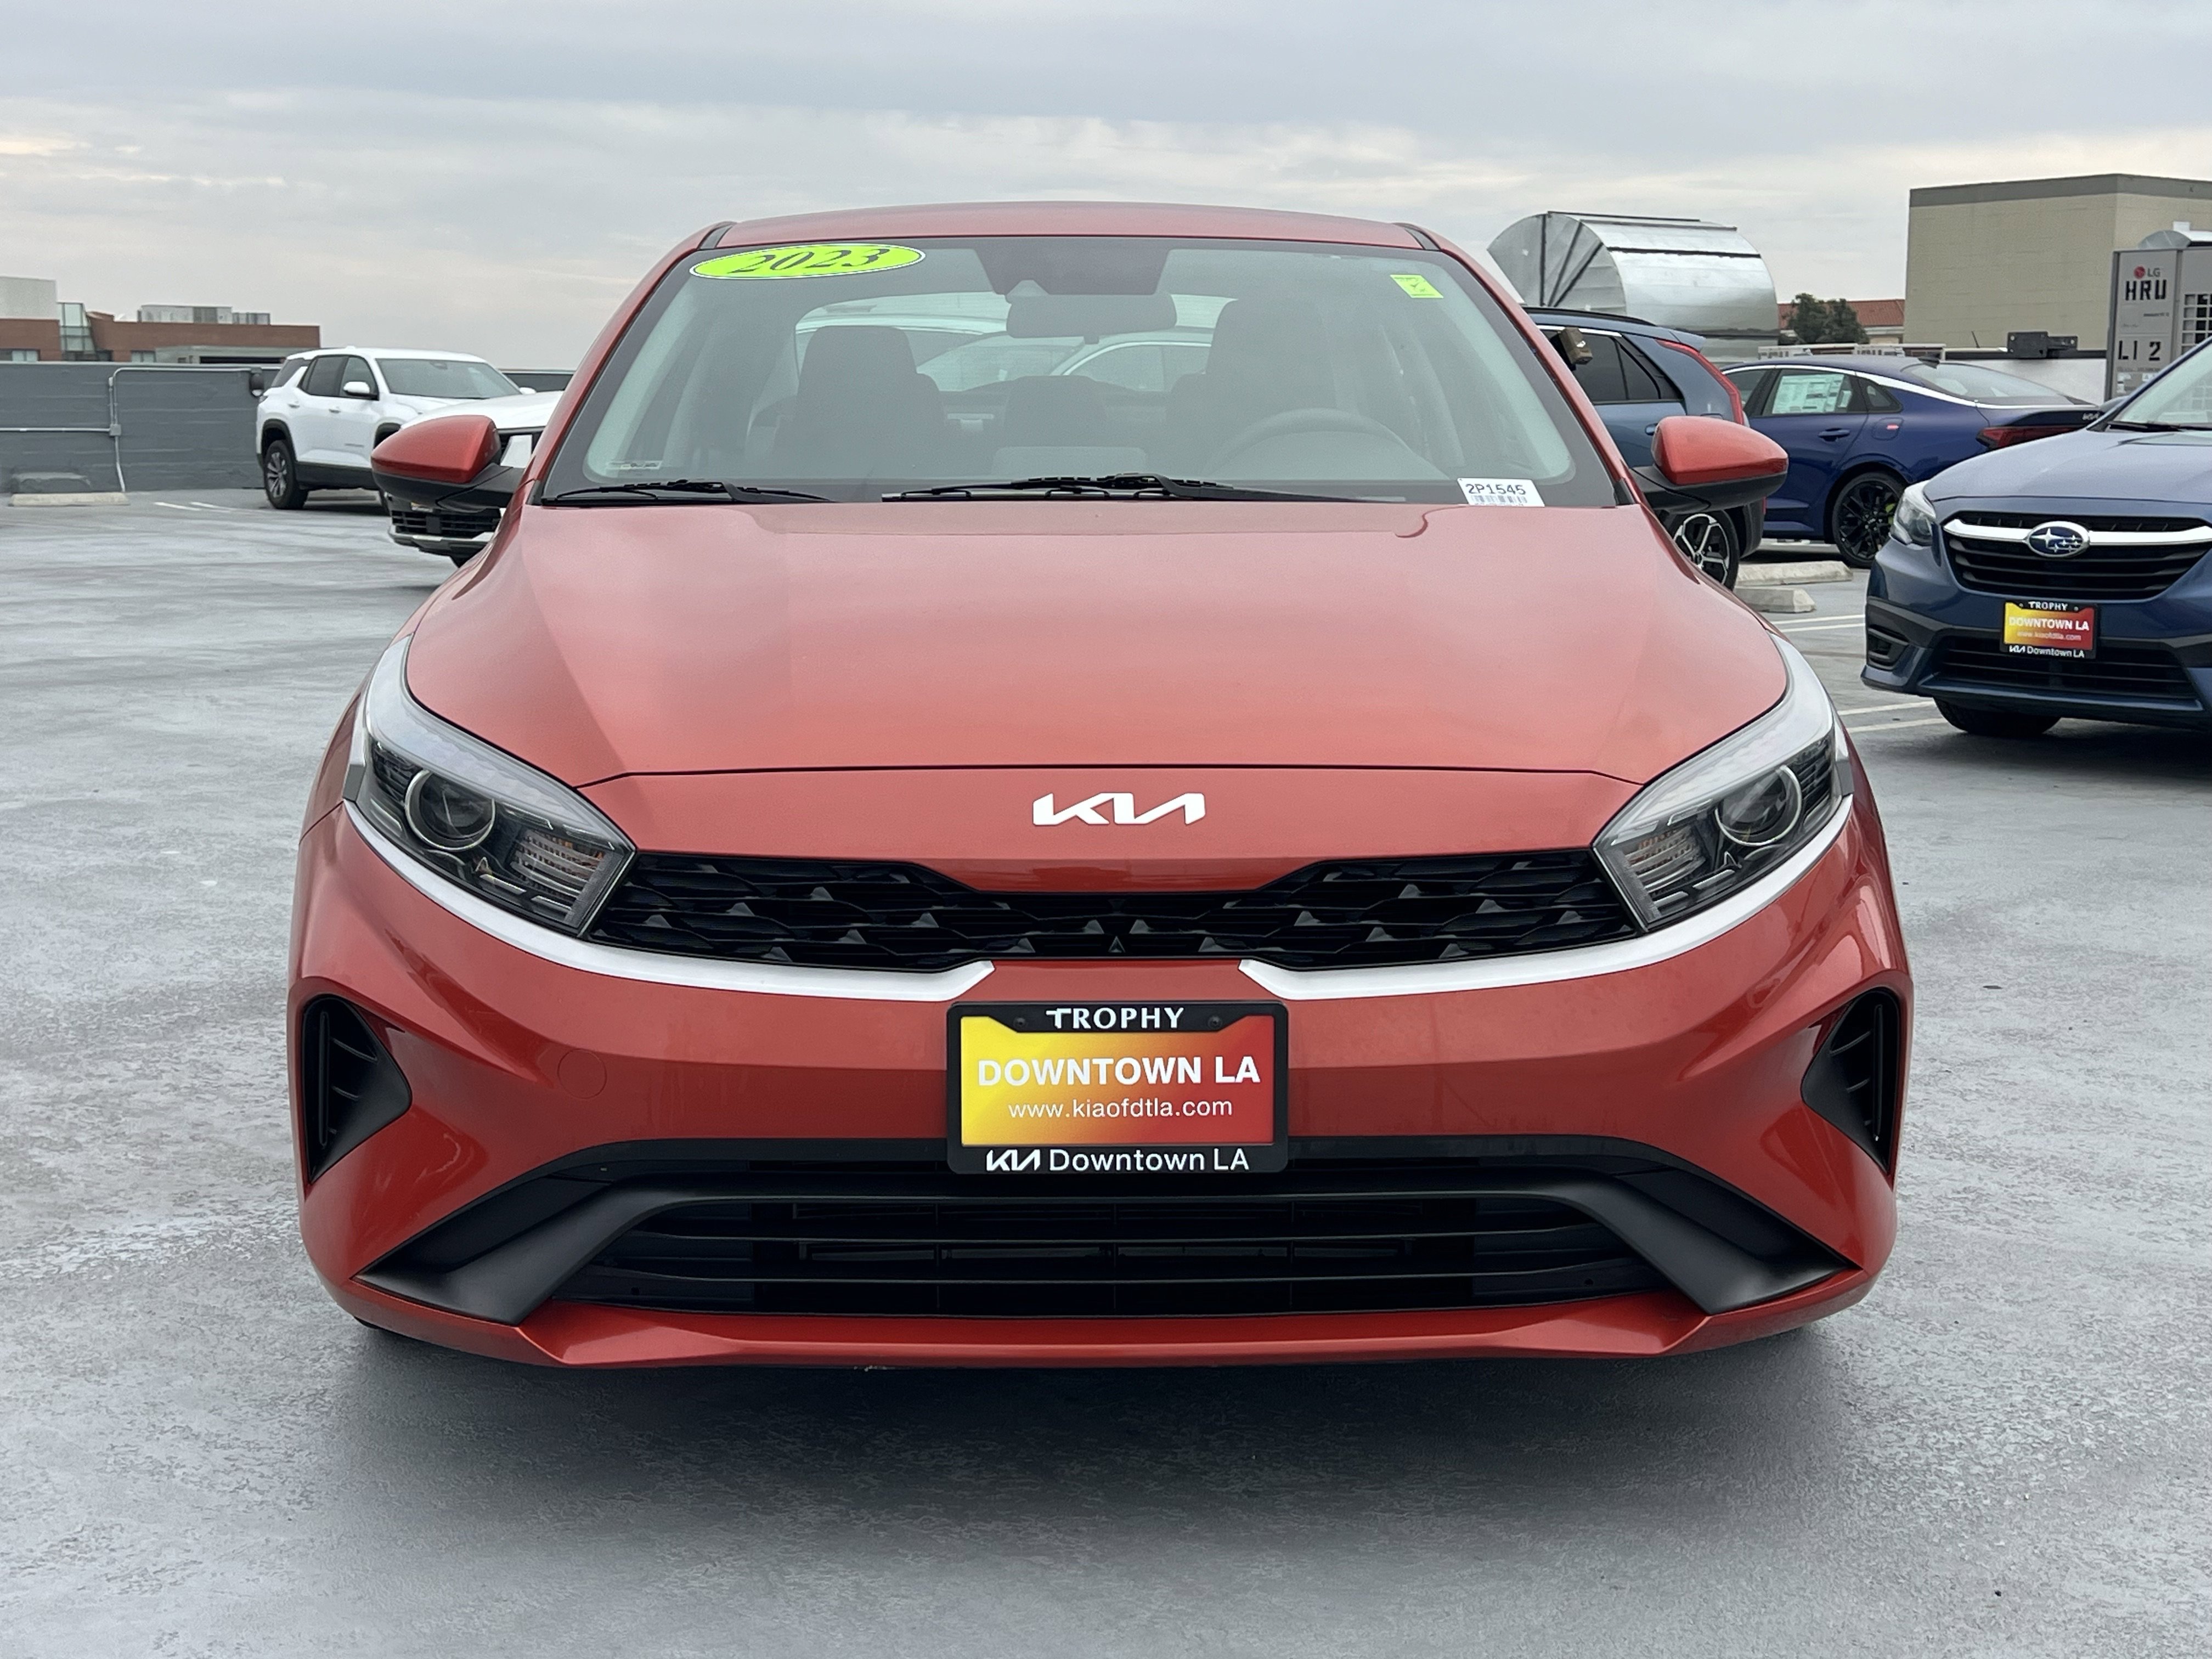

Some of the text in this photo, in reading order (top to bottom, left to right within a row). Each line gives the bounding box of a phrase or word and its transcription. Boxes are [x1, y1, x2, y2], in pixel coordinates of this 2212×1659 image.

[727, 248, 891, 274] 2023
[2147, 267, 2161, 278] LG
[2125, 279, 2167, 301] HRU
[1465, 483, 1526, 495] 2P1545
[2028, 601, 2068, 611] TROPHY
[2008, 617, 2090, 631] DOWNTOWN LA
[2027, 646, 2072, 657] Downtown
[2073, 649, 2085, 658] LA
[1032, 793, 1206, 826] KIA
[1046, 1007, 1184, 1029] TROPHY
[978, 1056, 1261, 1087] DOWNTOWN LA
[1008, 1098, 1233, 1119] www.kiaofdtla.com
[986, 1148, 1250, 1172] KIA Downtown LA
